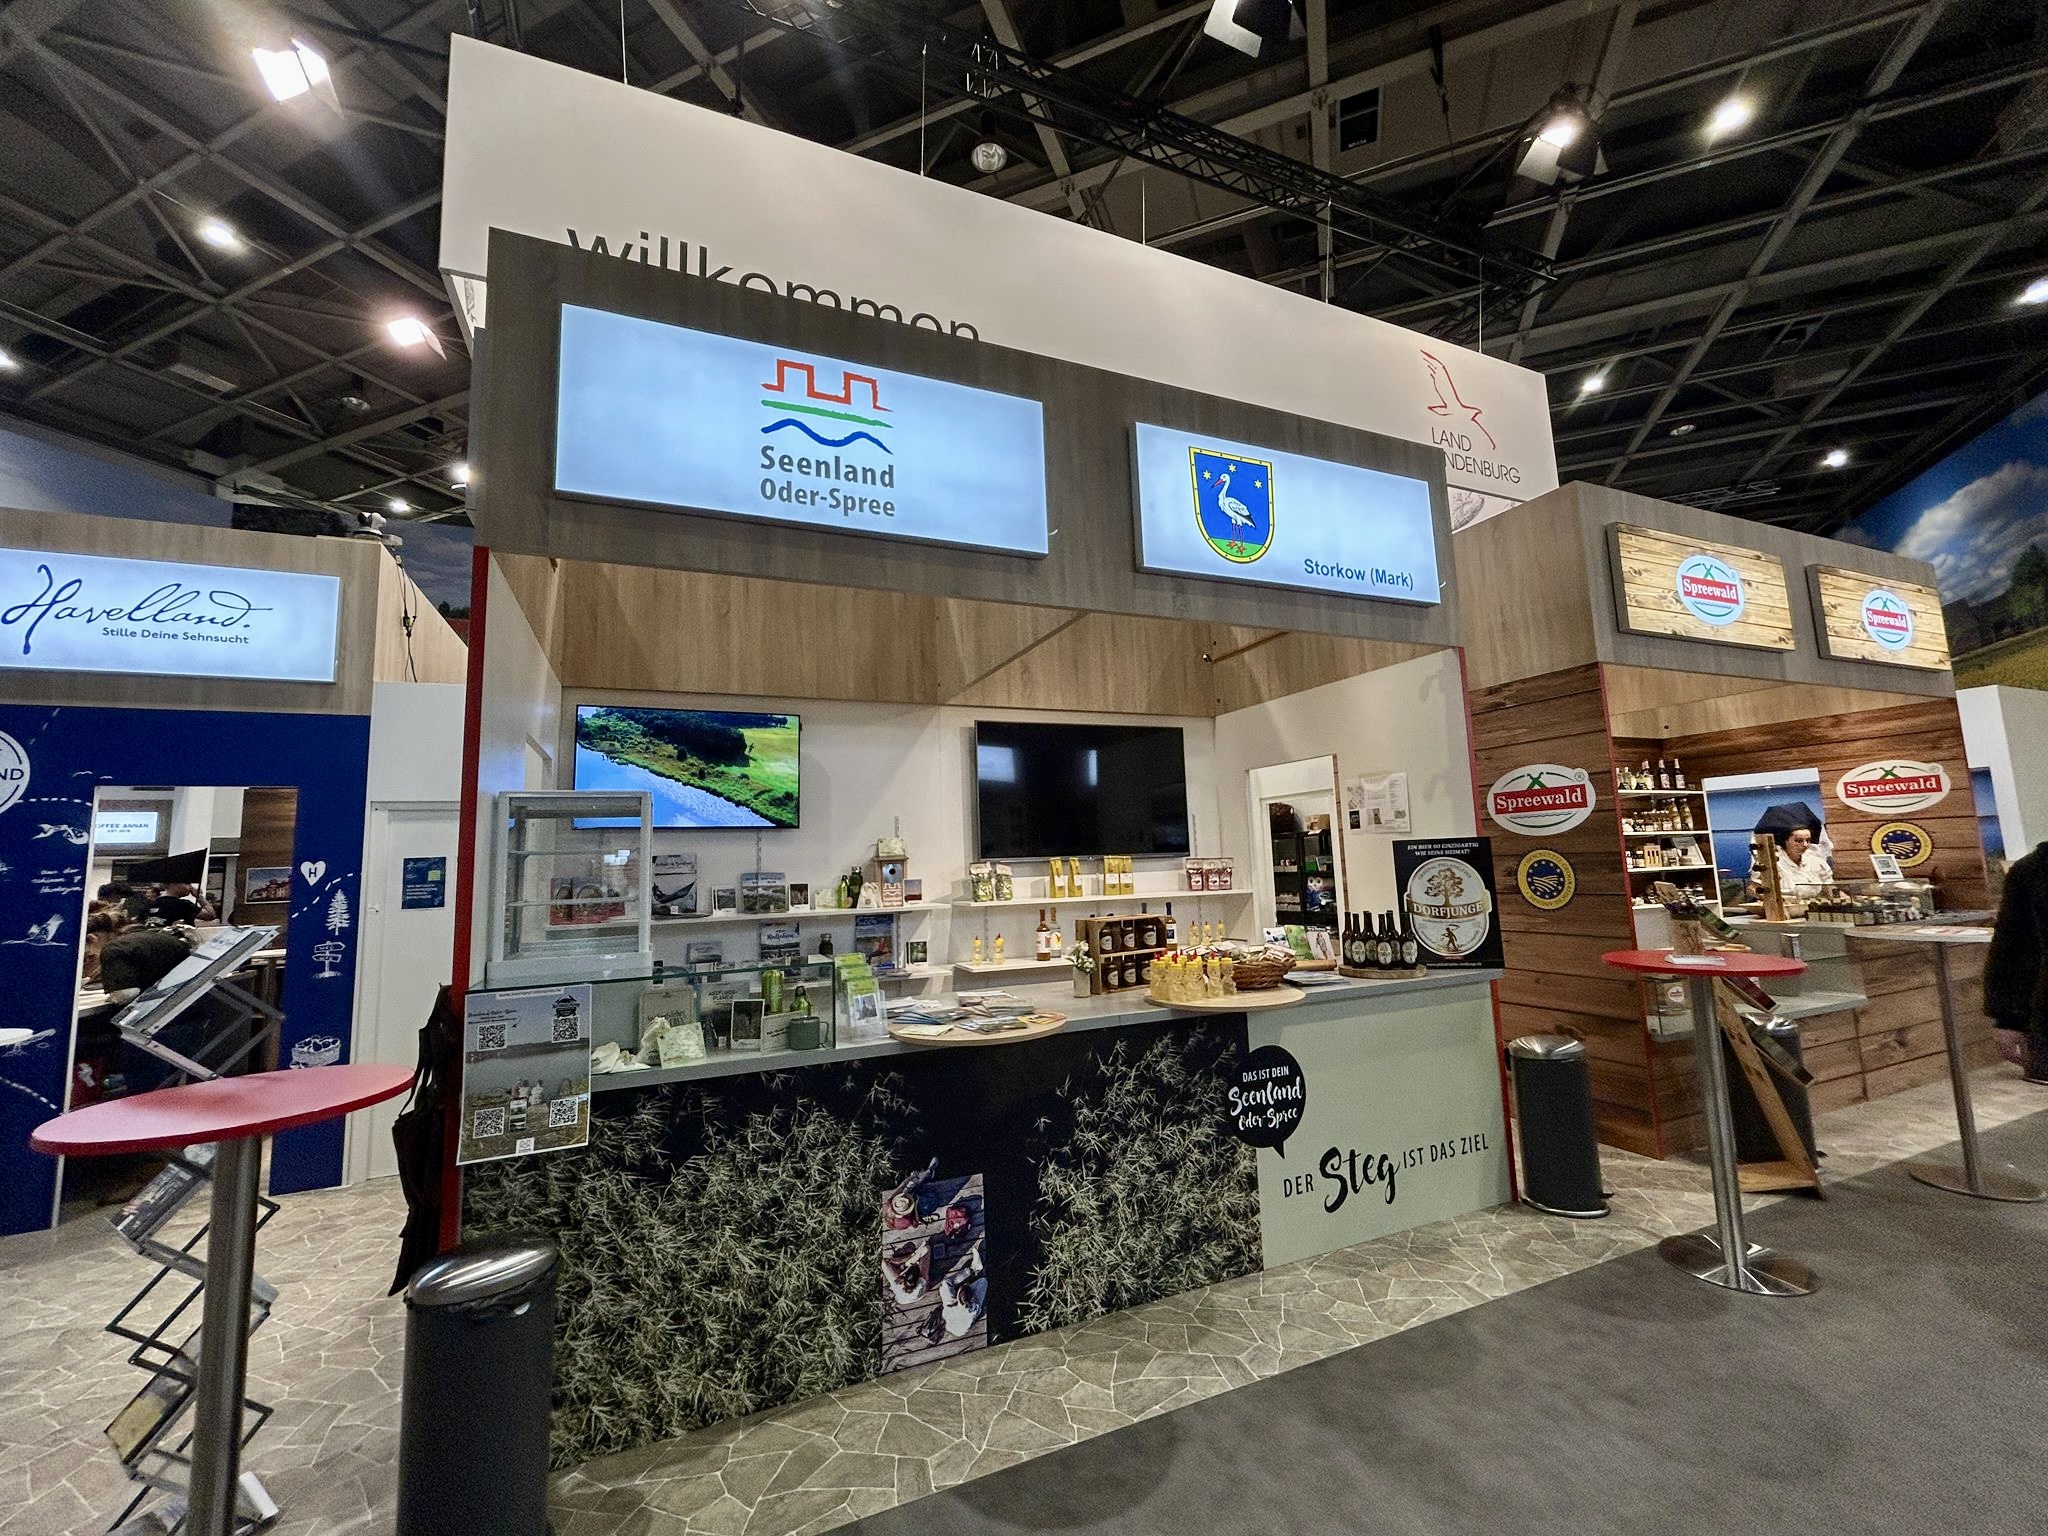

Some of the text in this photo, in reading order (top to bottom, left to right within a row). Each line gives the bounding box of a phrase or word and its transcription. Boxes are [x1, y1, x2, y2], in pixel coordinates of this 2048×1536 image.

[1431, 427, 1472, 451] LAND
[760, 445, 895, 489] Seenland
[1444, 452, 1521, 484] NDENBURG
[760, 478, 895, 516] Oder-Spree
[1304, 558, 1414, 591] Storkow (Mark)
[1683, 579, 1738, 600] Spreewald
[1867, 610, 1907, 628] Spreewald
[102, 627, 249, 644] Stille Deine Sehnsucht
[1847, 776, 1938, 796] Spreewald
[1496, 787, 1583, 812] Spreewald
[308, 867, 318, 878] H
[1413, 902, 1484, 918] DORFJUNGE
[1242, 1066, 1289, 1082] DAS IST DEIN
[1228, 1076, 1303, 1116] Seenland
[1283, 1133, 1489, 1213] DER Steg IST DAS ZIEL
